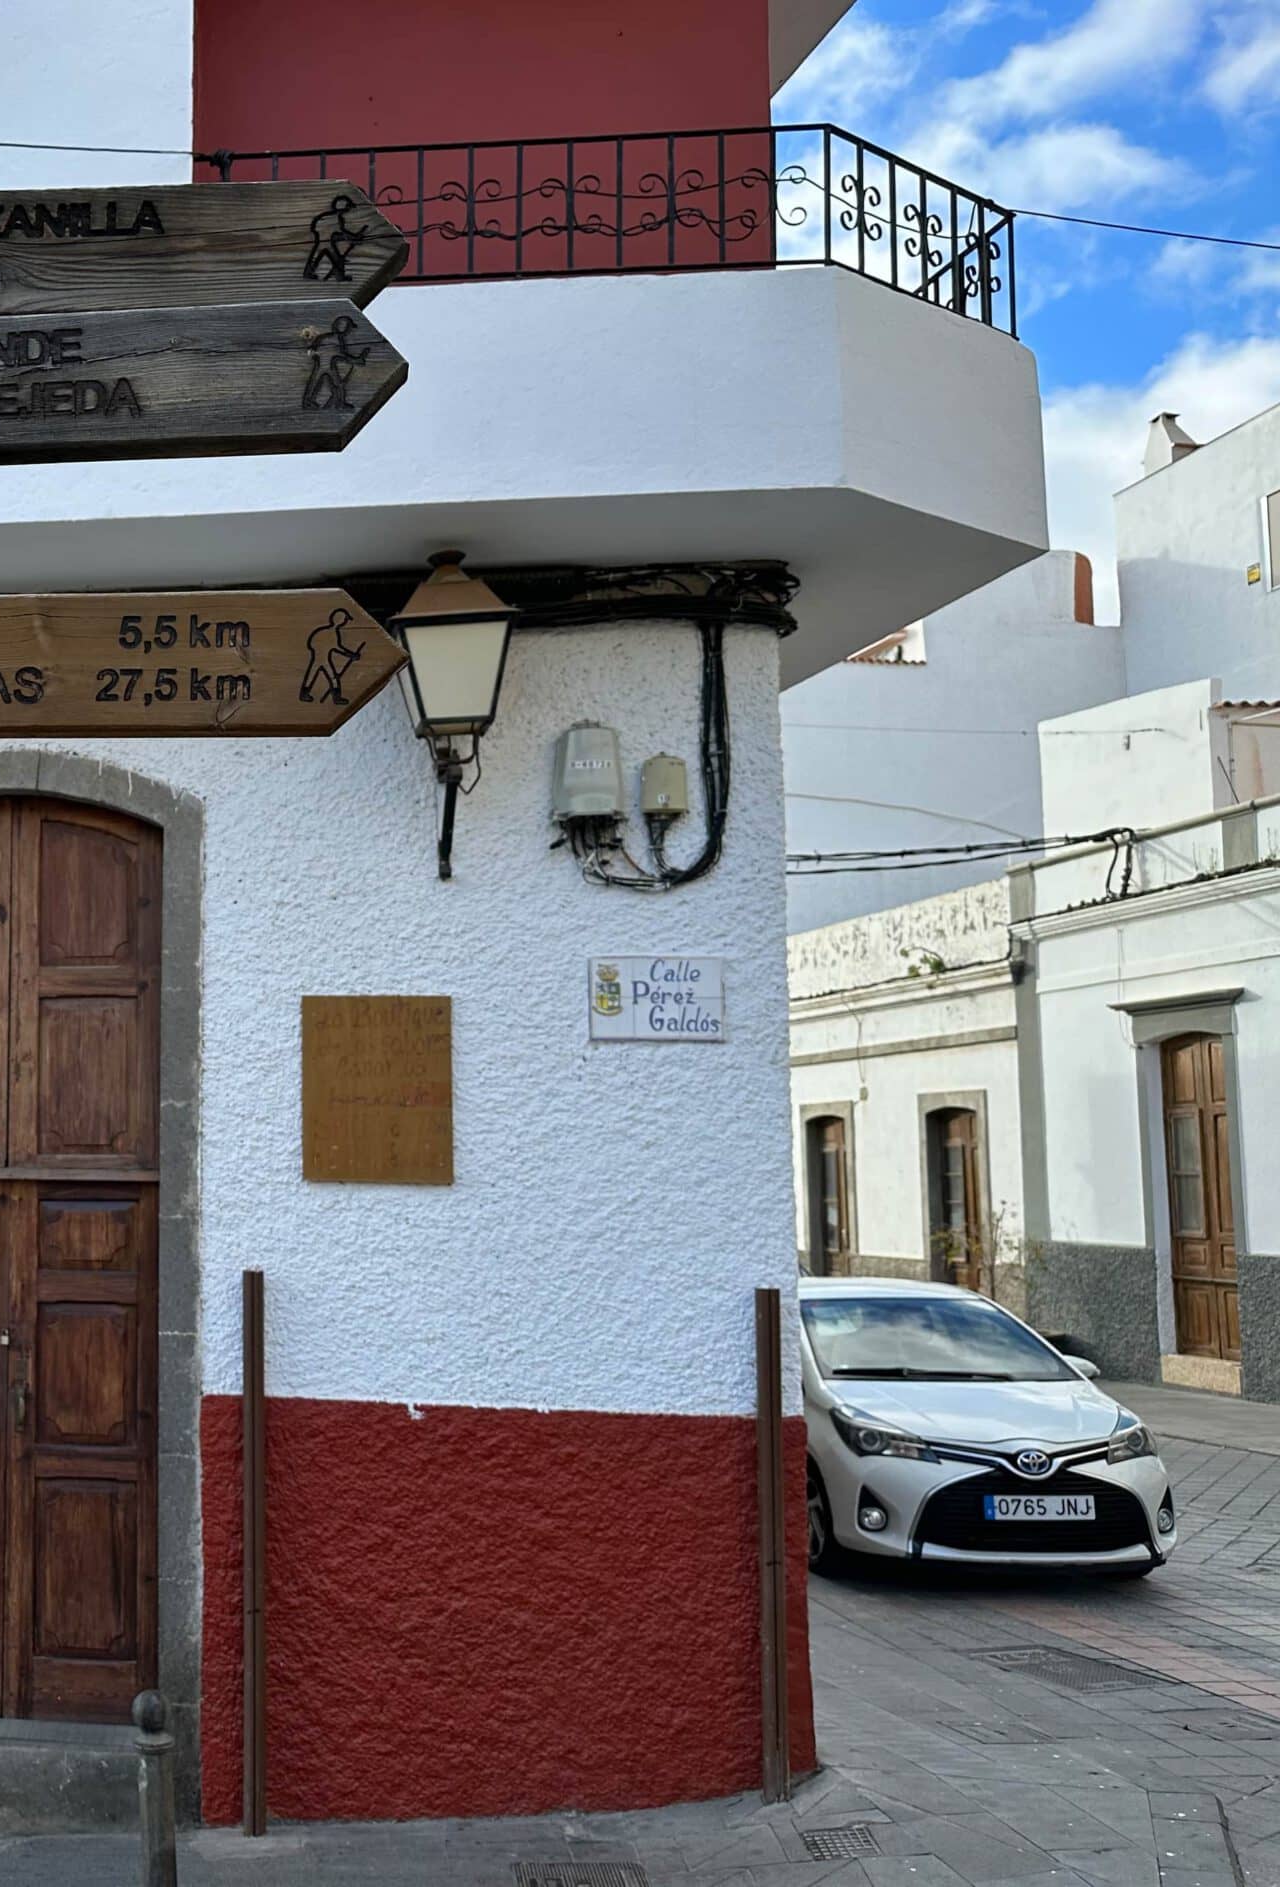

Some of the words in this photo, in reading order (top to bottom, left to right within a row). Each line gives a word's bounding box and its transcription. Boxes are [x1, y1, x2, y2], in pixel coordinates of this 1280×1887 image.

[118, 614, 178, 656] 5,5
[188, 614, 251, 649] km
[95, 667, 178, 707] 27,5
[189, 667, 252, 702] km
[650, 957, 701, 983] Calle
[631, 980, 697, 1005] Pérez
[648, 1005, 721, 1033] Galdós
[998, 1499, 1047, 1516] 0765
[1056, 1499, 1092, 1516] JNJ
